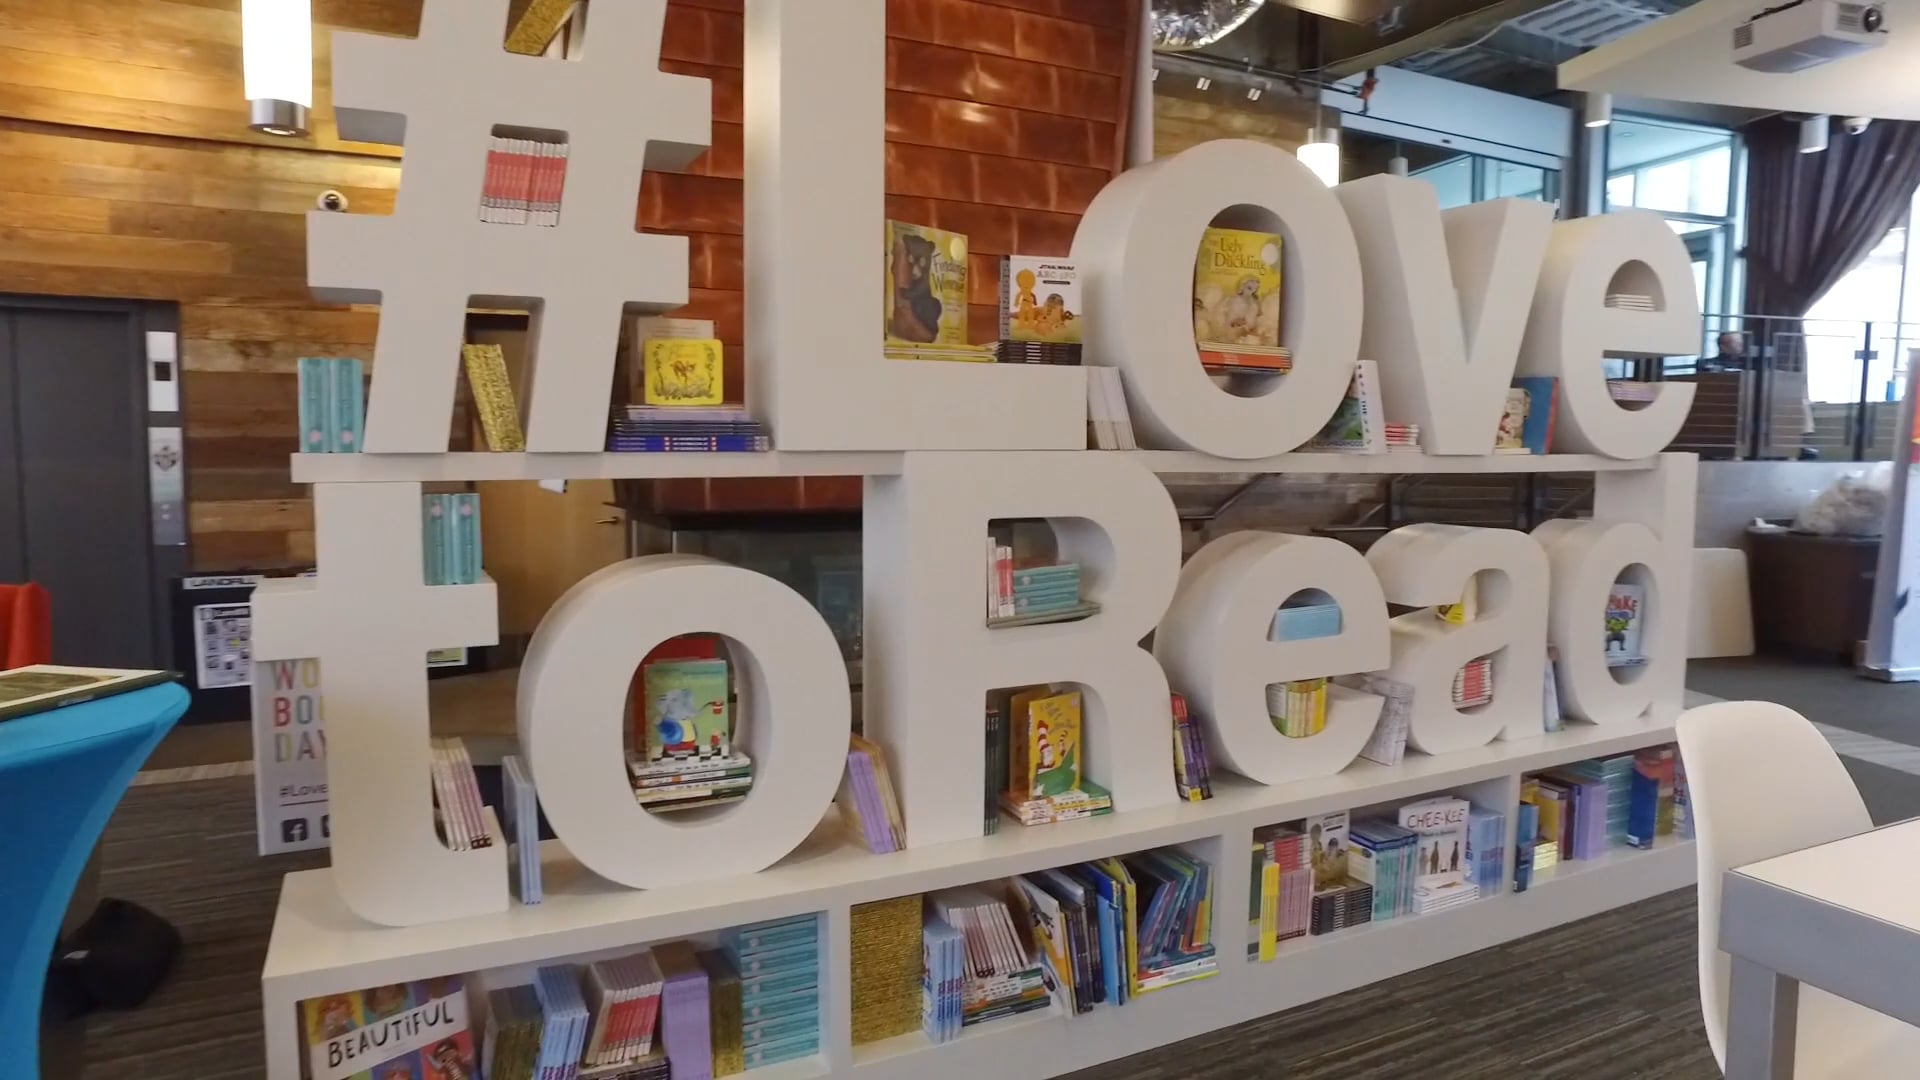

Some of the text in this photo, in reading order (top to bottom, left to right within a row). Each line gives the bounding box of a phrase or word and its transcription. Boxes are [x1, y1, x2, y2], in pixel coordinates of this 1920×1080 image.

[306, 0, 1703, 460] #Love
[1214, 251, 1266, 276] Duckling
[274, 695, 325, 727] BO
